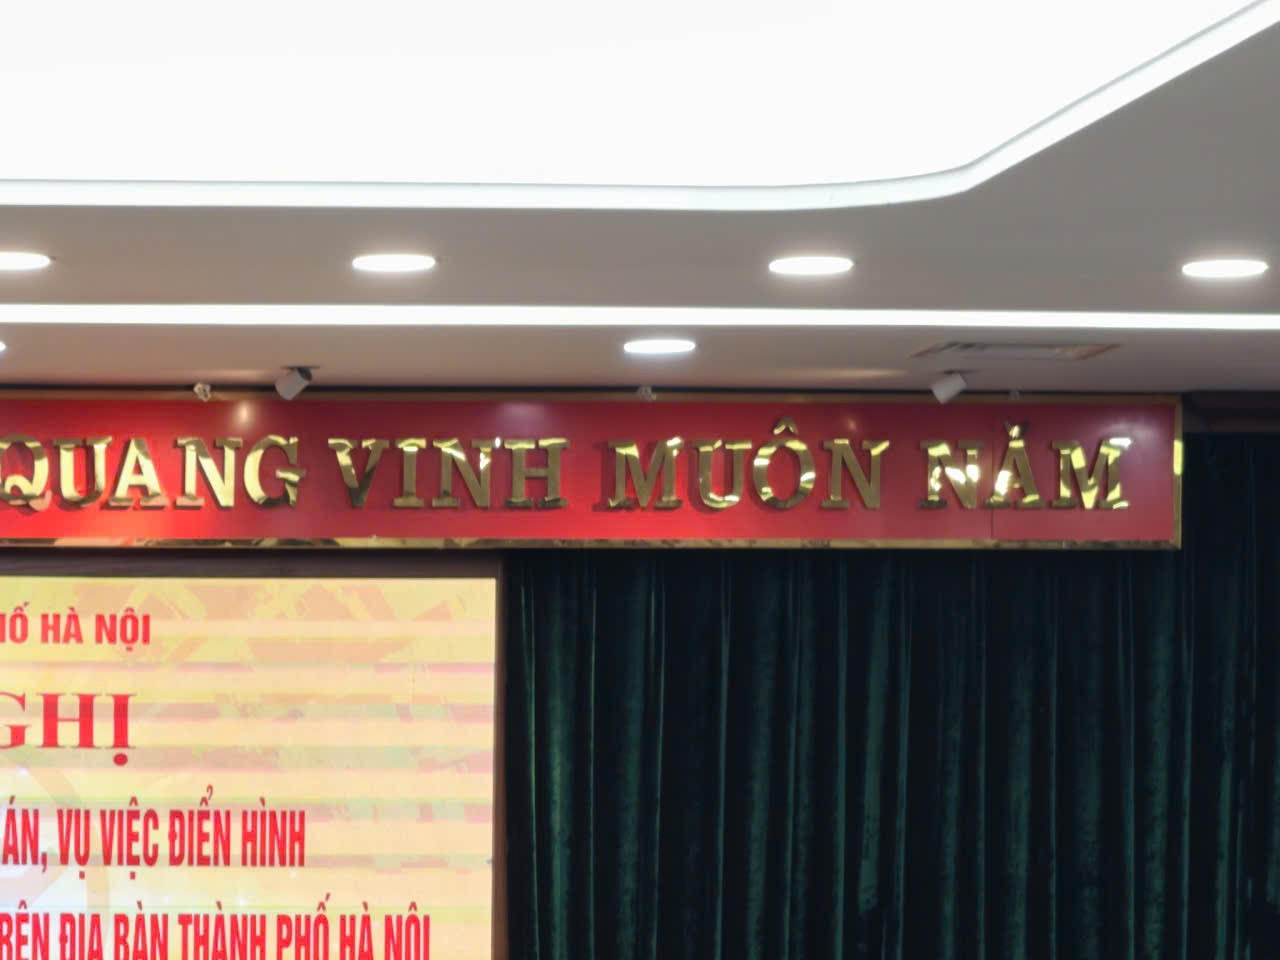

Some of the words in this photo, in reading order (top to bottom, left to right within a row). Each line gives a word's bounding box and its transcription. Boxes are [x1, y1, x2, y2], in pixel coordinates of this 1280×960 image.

[327, 438, 569, 508] VINH
[606, 417, 889, 509] MUÔN
[920, 421, 1131, 510] NĂM
[41, 607, 83, 644] HÀ
[95, 608, 151, 652] NỘI
[2, 796, 47, 872] ÁN,
[57, 808, 91, 880] VỤ
[99, 797, 159, 880] VIỆC
[168, 785, 231, 867] ĐIỂN
[241, 797, 306, 867] HÌNH
